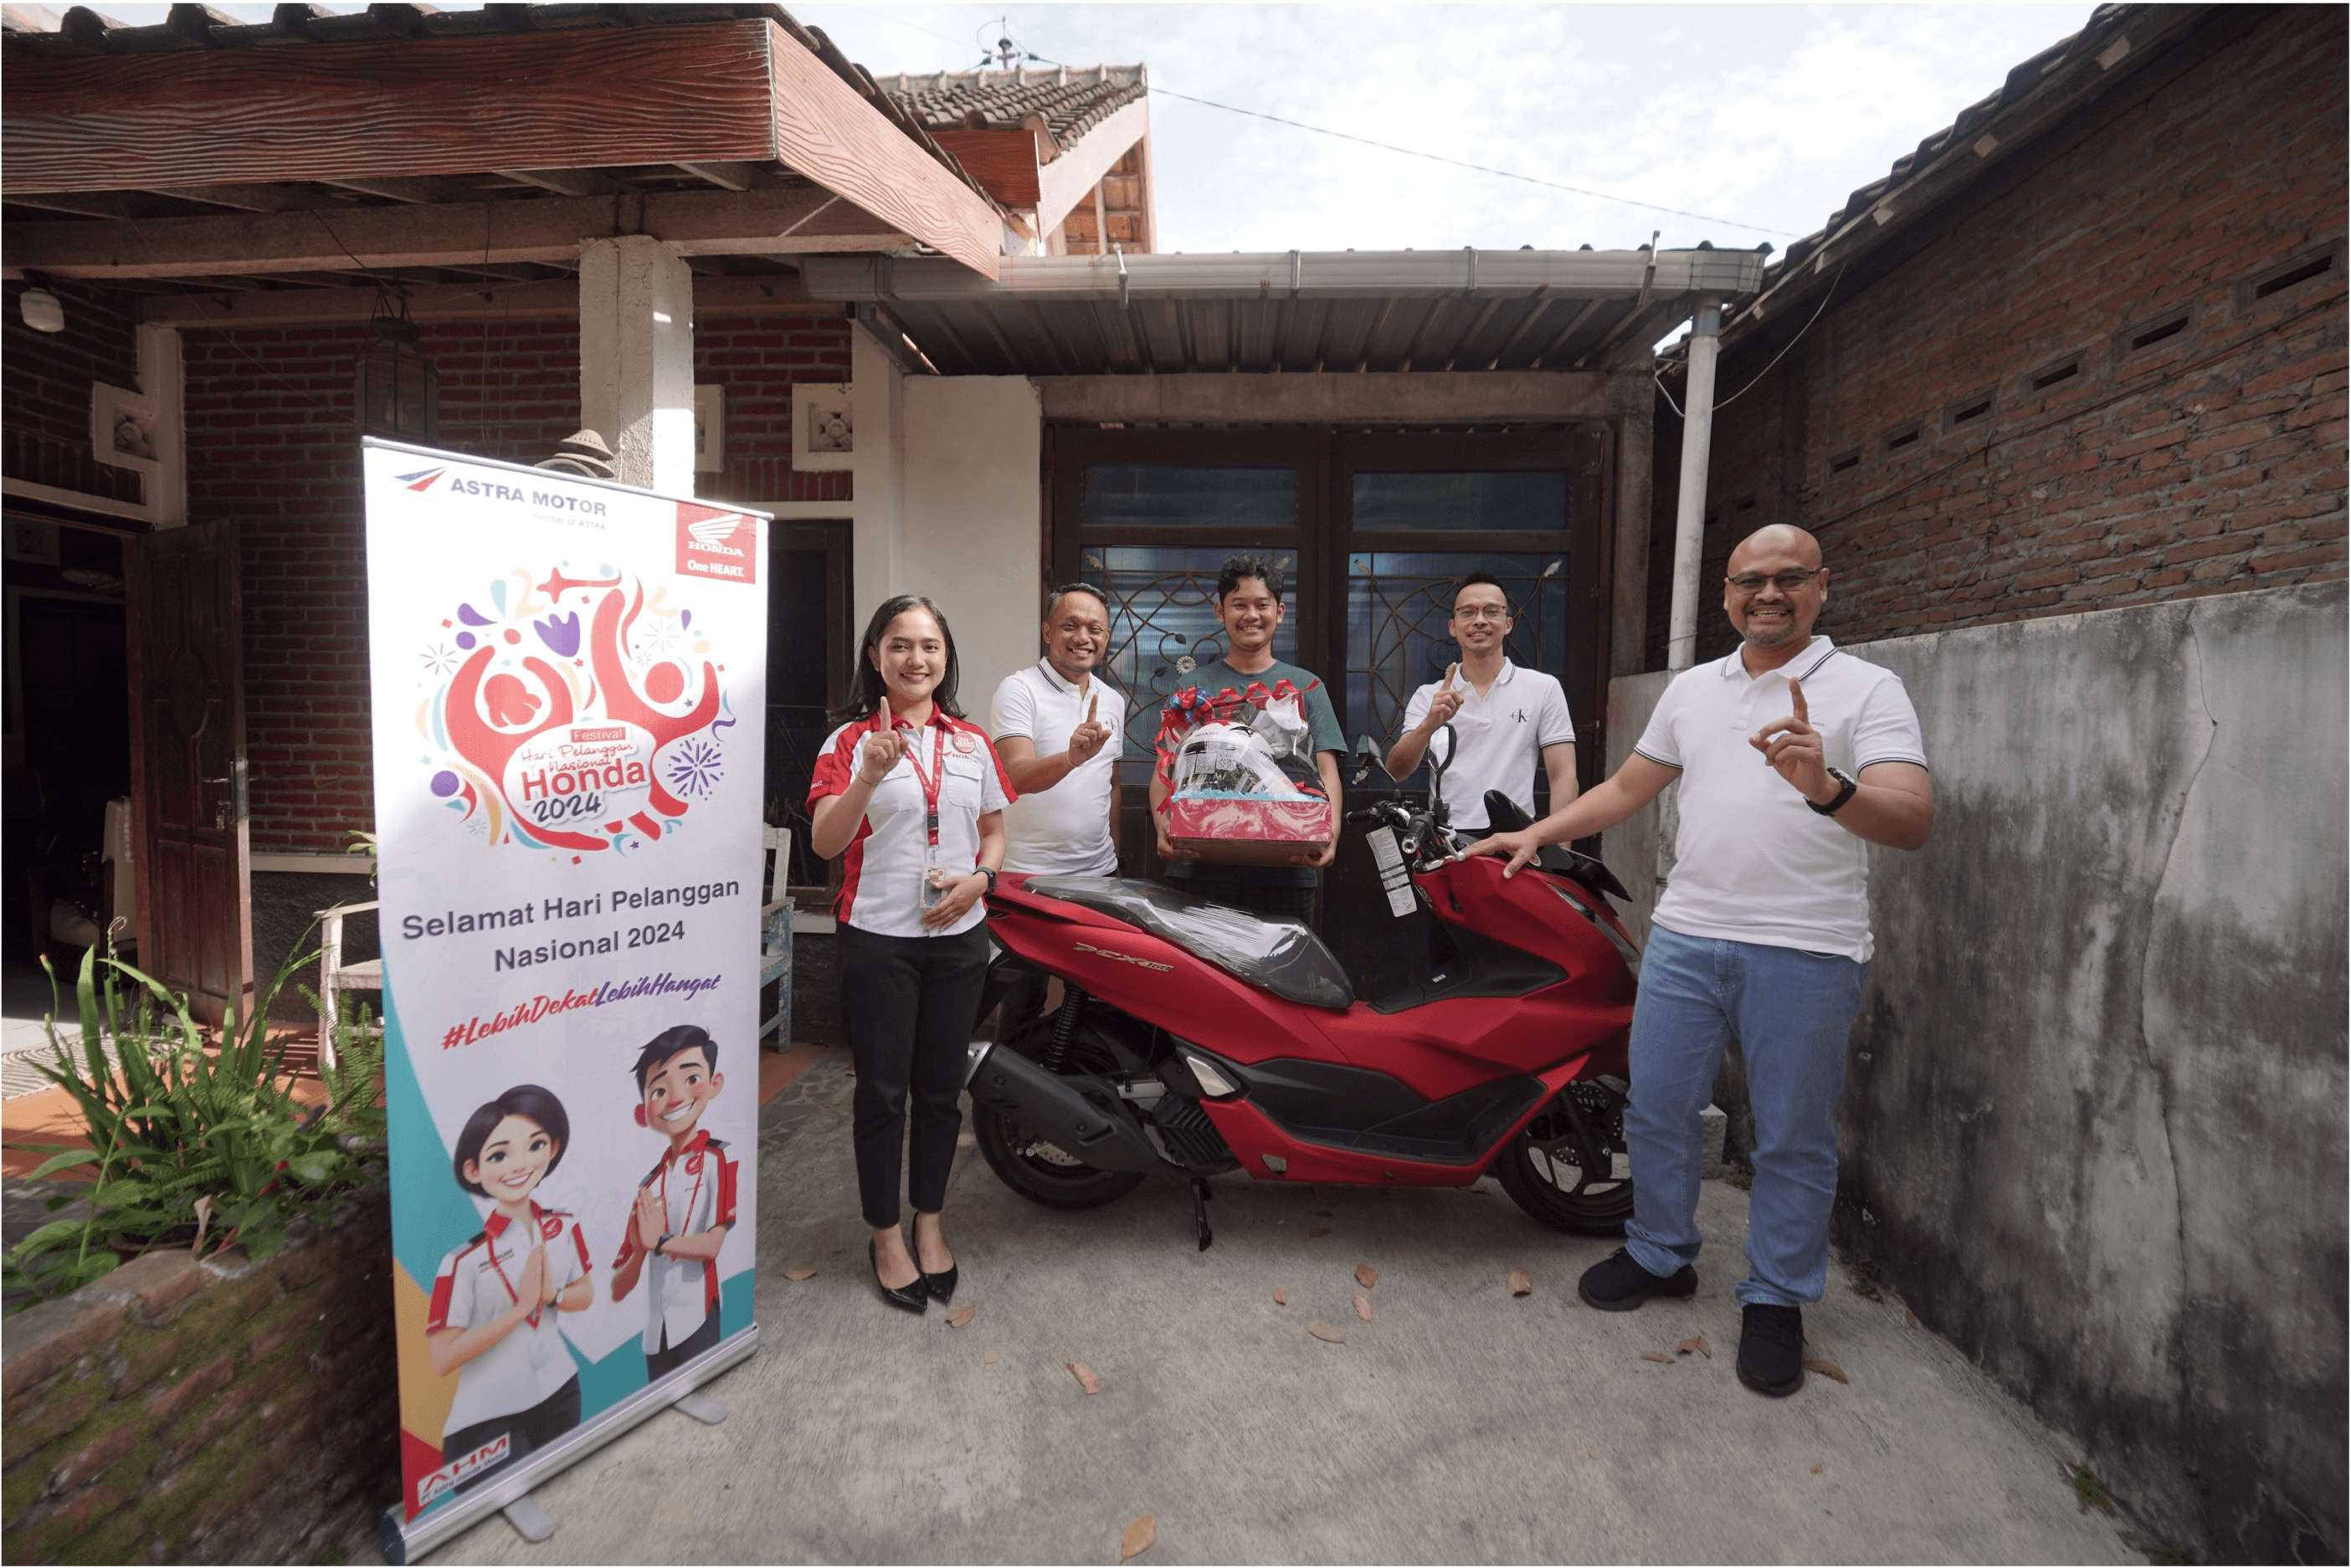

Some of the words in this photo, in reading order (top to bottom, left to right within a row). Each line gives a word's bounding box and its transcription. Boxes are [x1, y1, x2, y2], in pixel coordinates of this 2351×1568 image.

[450, 478, 525, 502] ASTRA
[532, 491, 607, 516] MOTOR
[578, 520, 606, 530] ASTRA
[688, 541, 745, 557] HONDA
[687, 559, 709, 572] One
[573, 729, 622, 741] Festival
[521, 749, 553, 761] Hari
[557, 744, 633, 758] Pelanggan
[549, 756, 612, 772] Nasional
[521, 757, 646, 802] Honda
[532, 792, 602, 822] 2024
[403, 903, 534, 940] Selamat
[544, 893, 601, 920] Hari
[612, 880, 739, 912] Pelanggan
[495, 930, 619, 972] Nasional
[627, 920, 685, 949] 2024
[442, 972, 721, 1051] #LebihDekatLebihHangat
[424, 1437, 507, 1494] AHM
[433, 1480, 454, 1495] Astra
[456, 1465, 481, 1482] Honda
